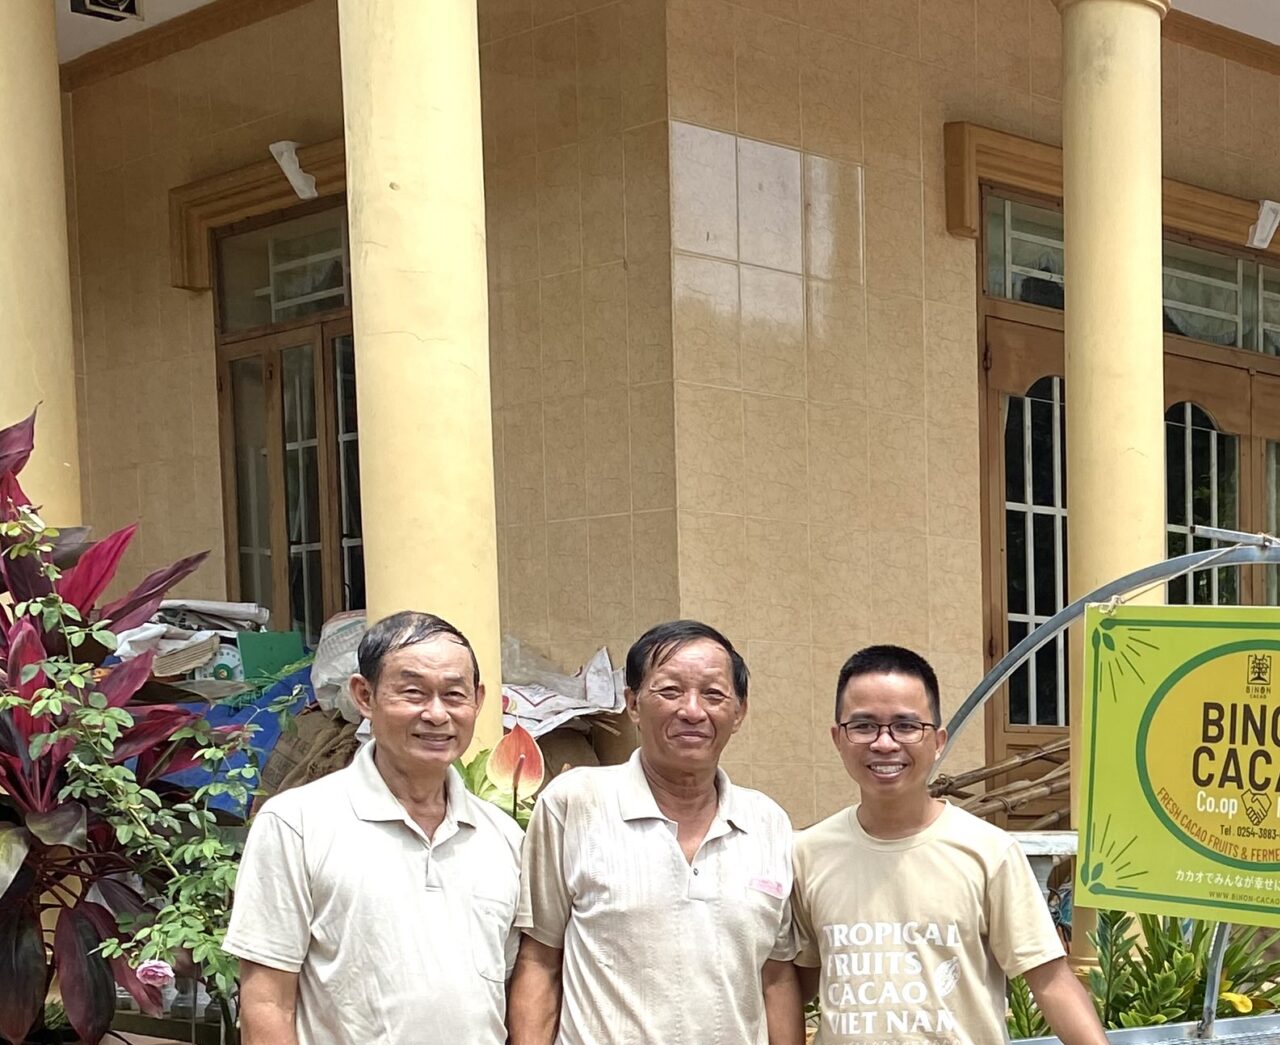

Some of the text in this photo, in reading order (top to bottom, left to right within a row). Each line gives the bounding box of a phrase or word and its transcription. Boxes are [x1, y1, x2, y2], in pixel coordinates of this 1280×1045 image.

[1196, 791, 1238, 819] Co.op
[1157, 787, 1182, 820] FRESH
[1180, 814, 1208, 842] CACAO
[1207, 834, 1239, 858] FRUITS
[1241, 846, 1248, 860] &
[822, 921, 961, 947] TROPICAL
[827, 951, 922, 977] FRUITS
[828, 980, 928, 1006] CACAO
[825, 1008, 956, 1035] VIET NAM
